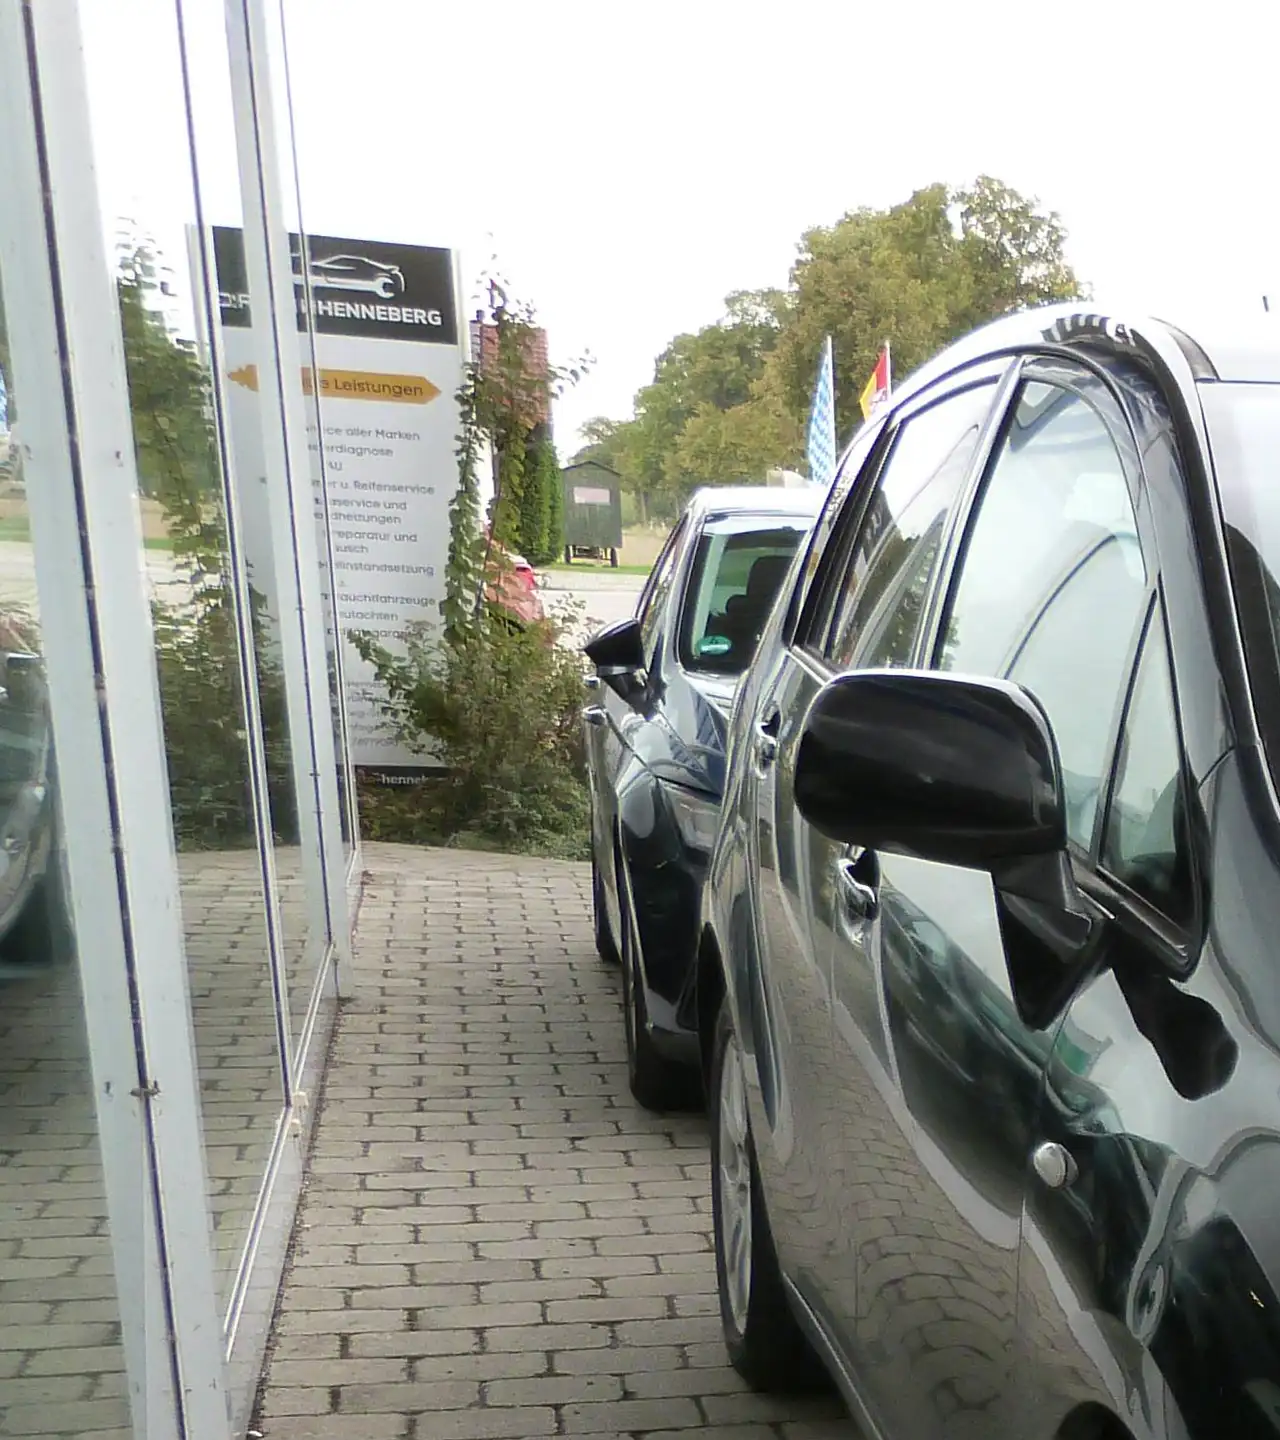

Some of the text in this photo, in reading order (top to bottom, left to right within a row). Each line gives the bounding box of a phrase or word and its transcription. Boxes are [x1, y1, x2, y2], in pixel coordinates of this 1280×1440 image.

[317, 300, 442, 327] HENNEBERG
[334, 378, 424, 398] Leistungen
[375, 429, 421, 441] Marken
[354, 480, 435, 495] Reifenservice
[394, 533, 418, 542] und
